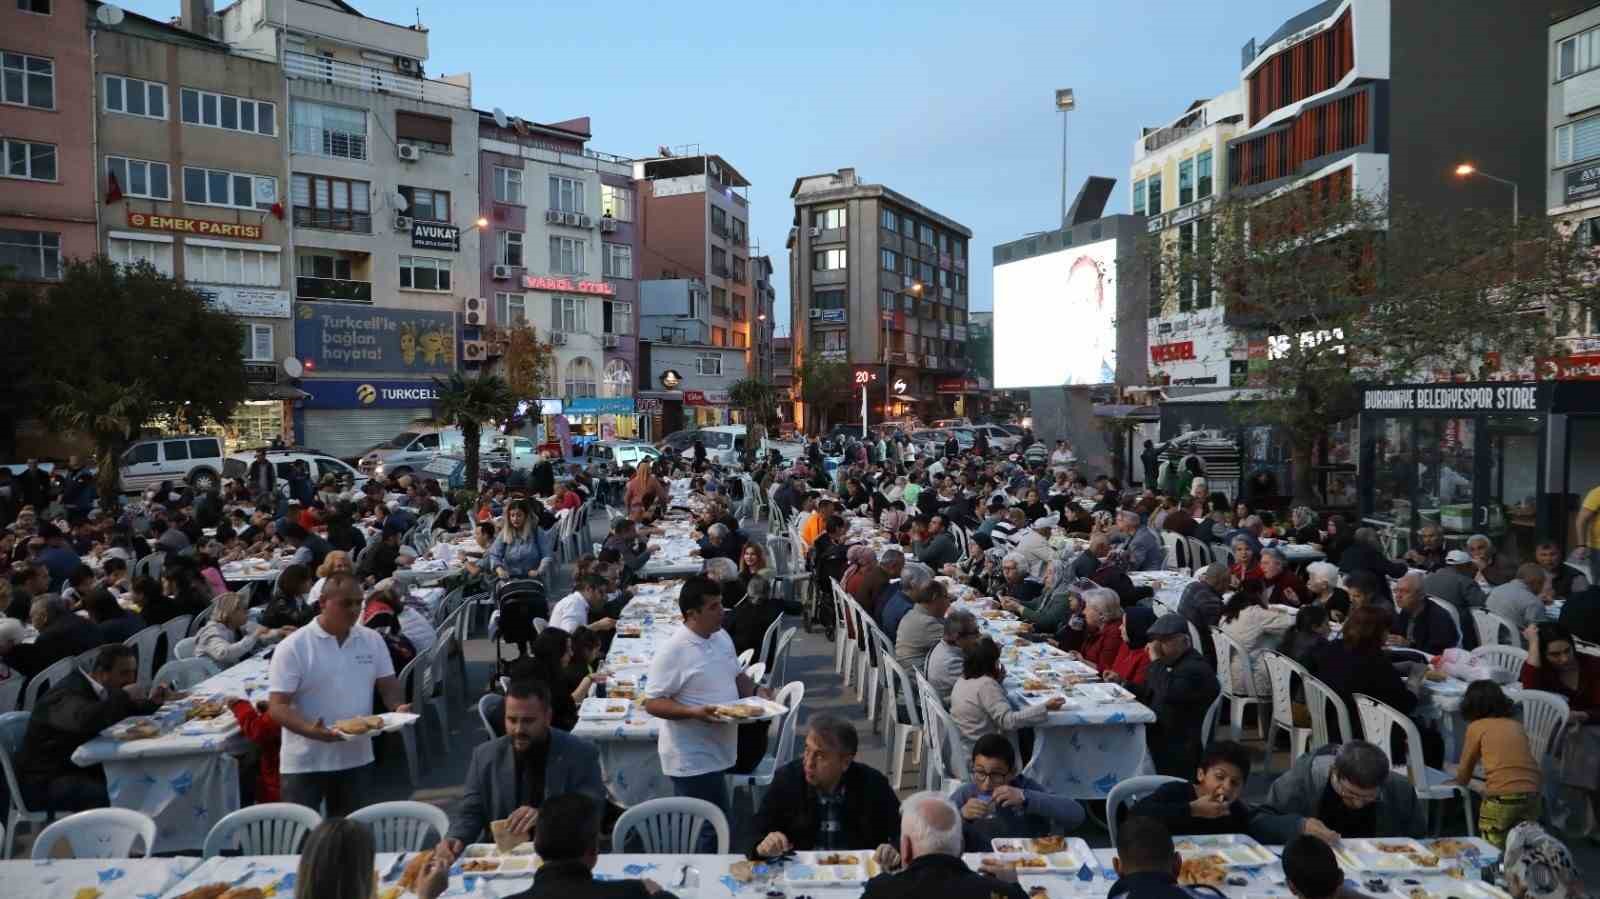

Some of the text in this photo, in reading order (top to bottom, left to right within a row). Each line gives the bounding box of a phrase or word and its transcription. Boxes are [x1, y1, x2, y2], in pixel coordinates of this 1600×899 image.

[150, 216, 259, 238] EMEK PARTİSİ
[416, 226, 457, 239] AVUKAT
[322, 330, 376, 346] bağlan
[322, 347, 383, 361] hayata!
[855, 371, 869, 382] 20
[1497, 387, 1537, 409] STORE
